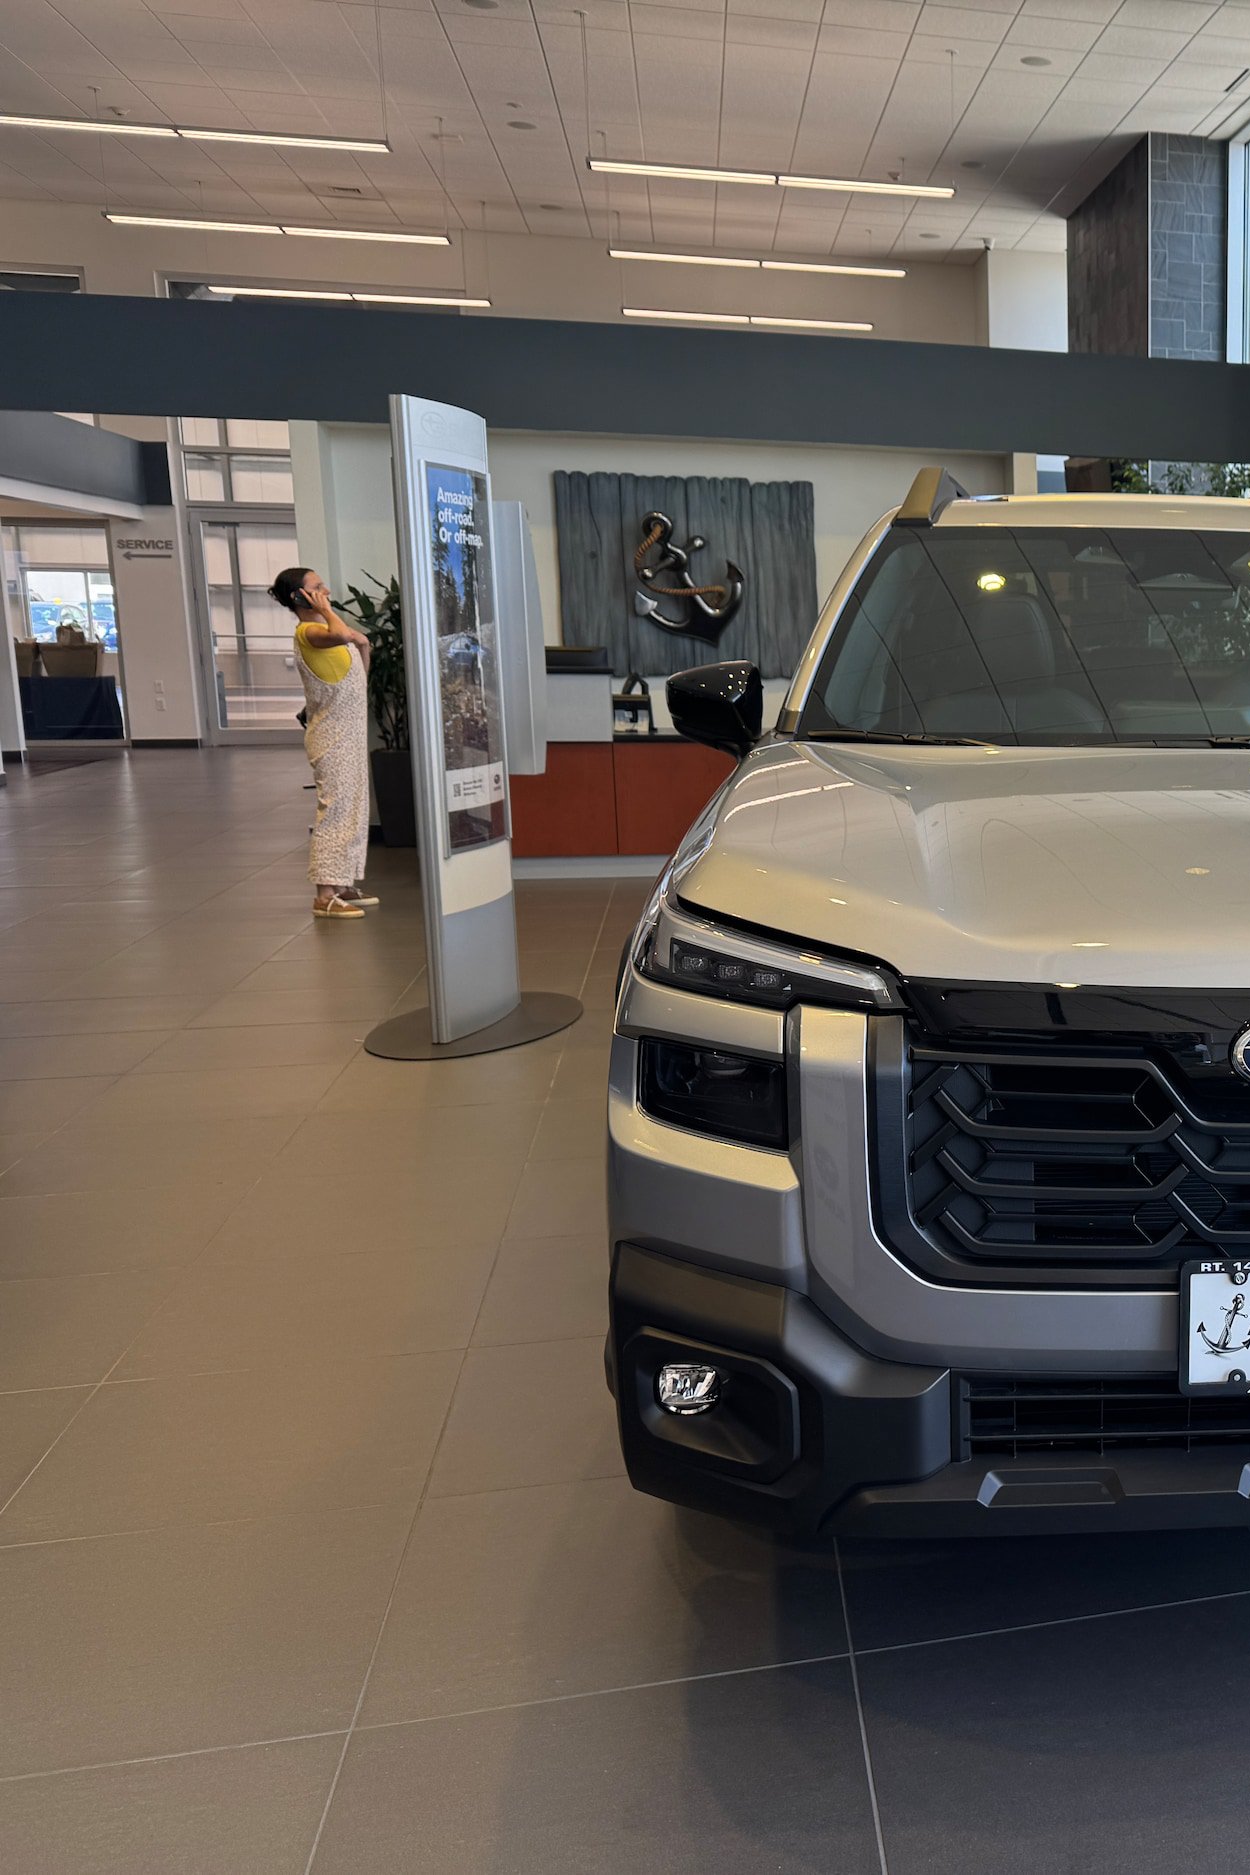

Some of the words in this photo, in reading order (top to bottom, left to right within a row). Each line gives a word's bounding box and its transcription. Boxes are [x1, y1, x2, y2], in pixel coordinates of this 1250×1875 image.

[437, 486, 473, 510] Amazing
[438, 508, 474, 526] off-road.
[117, 539, 173, 549] SERVICE
[439, 527, 452, 543] Or
[454, 529, 483, 549] off-map.
[1200, 1262, 1226, 1272] RT.
